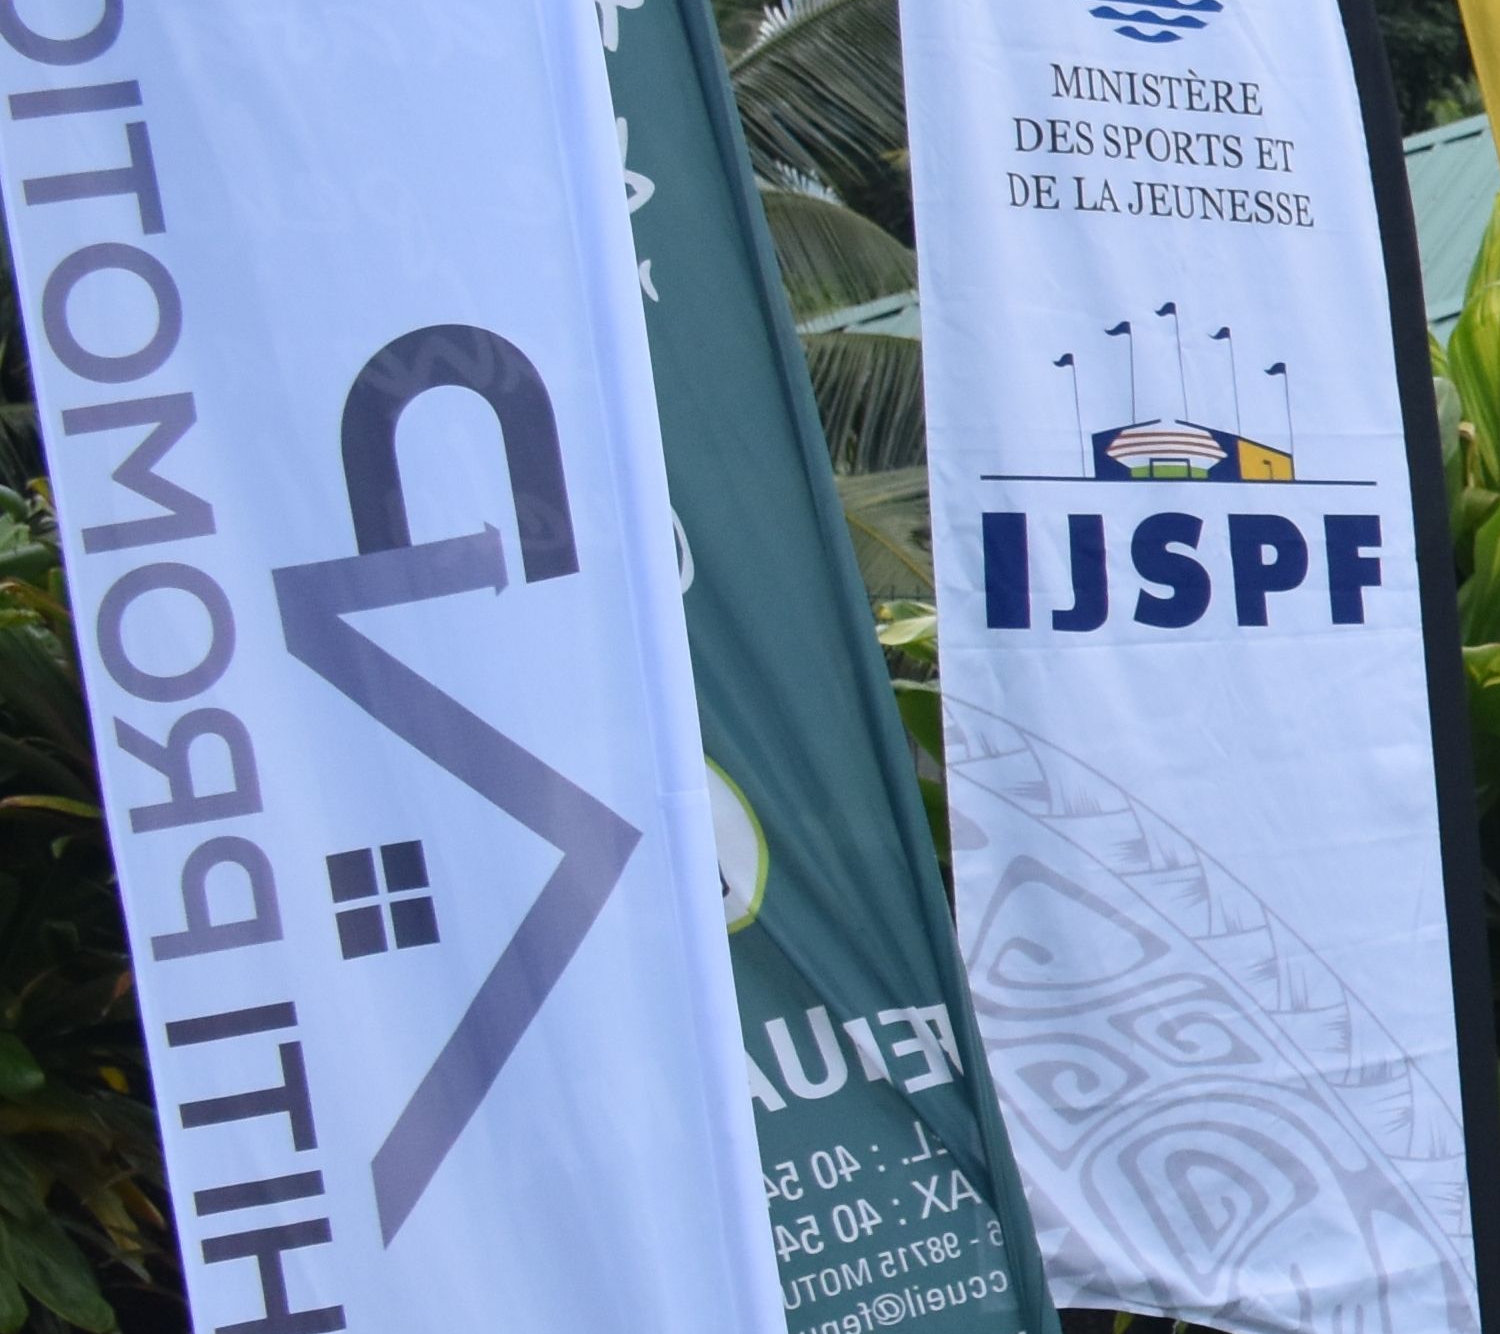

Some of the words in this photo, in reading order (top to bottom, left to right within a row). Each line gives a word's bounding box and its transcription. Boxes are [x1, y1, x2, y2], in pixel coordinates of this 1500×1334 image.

[1050, 63, 1263, 117] MINISTÈRE
[1013, 116, 1094, 156] DES
[1102, 121, 1243, 170] SPORTS
[1257, 137, 1295, 174] ET
[1006, 170, 1060, 211] DE
[1073, 176, 1120, 213] LA
[1127, 179, 1315, 229] JEUNESSE
[981, 511, 1383, 634] IJSPF
